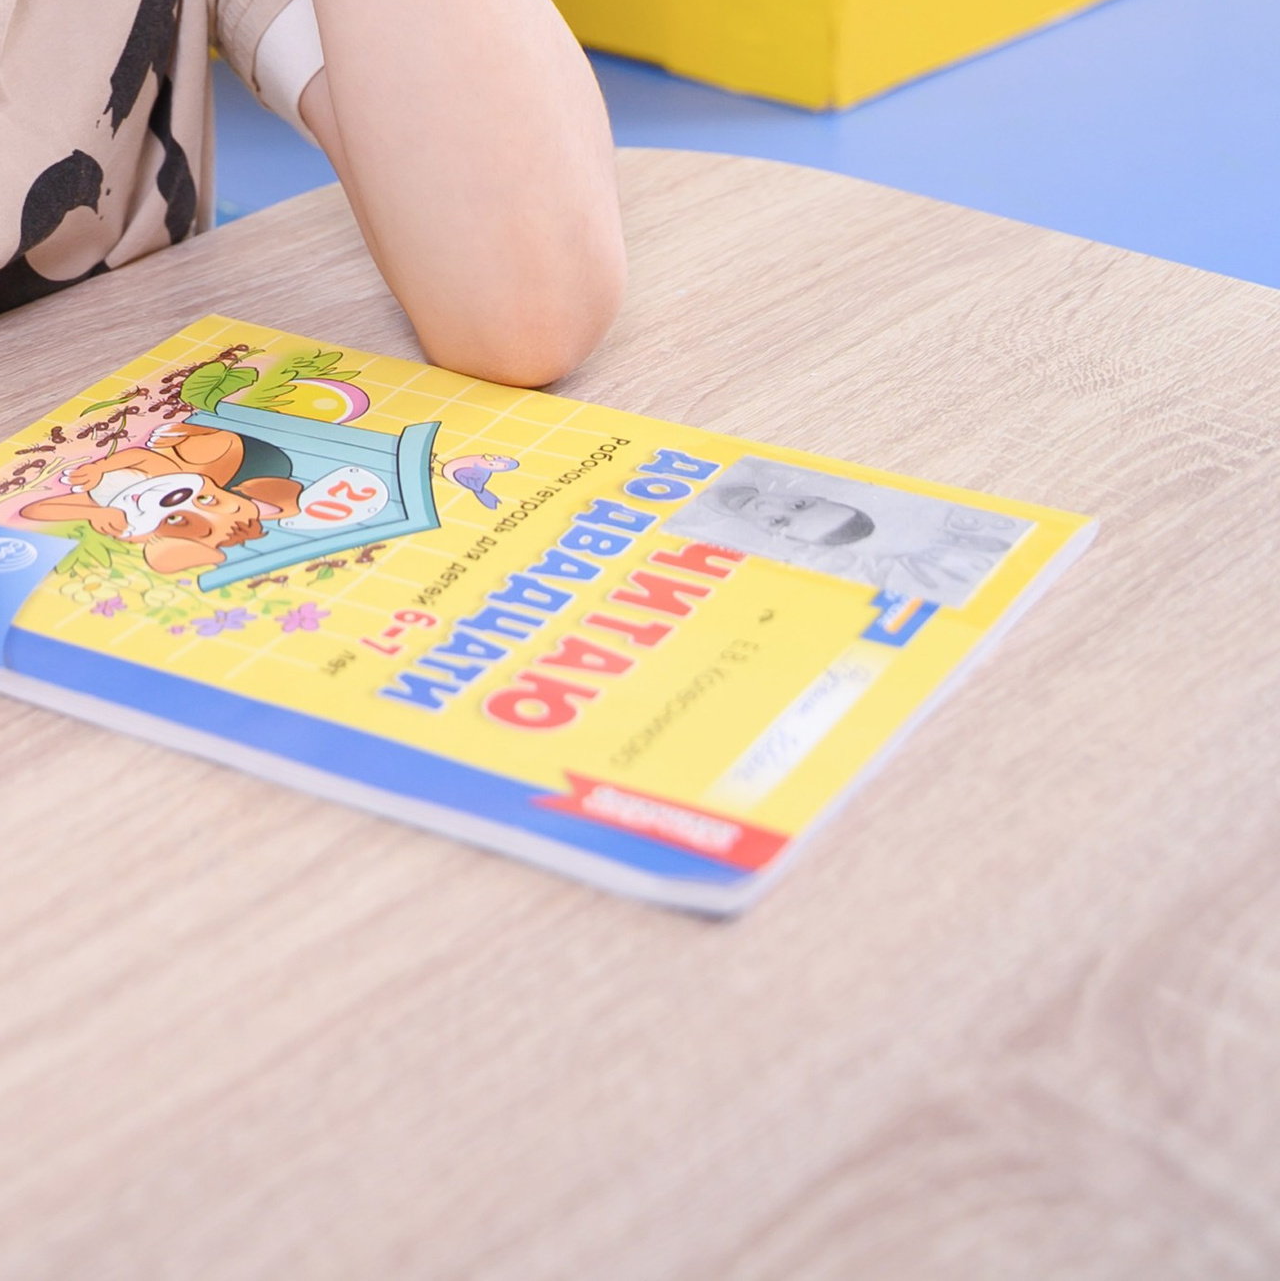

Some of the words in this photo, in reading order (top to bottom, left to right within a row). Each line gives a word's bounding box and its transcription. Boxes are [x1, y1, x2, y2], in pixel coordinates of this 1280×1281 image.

[554, 436, 631, 486] Рабочая
[624, 449, 722, 502] ДО
[304, 480, 377, 521] 20
[493, 485, 562, 535] тетрадь
[463, 535, 498, 561] для
[377, 498, 658, 711] ДВАДЦАТИ
[413, 561, 467, 606] детей
[359, 609, 437, 656] 6-7
[322, 648, 357, 677] лет
